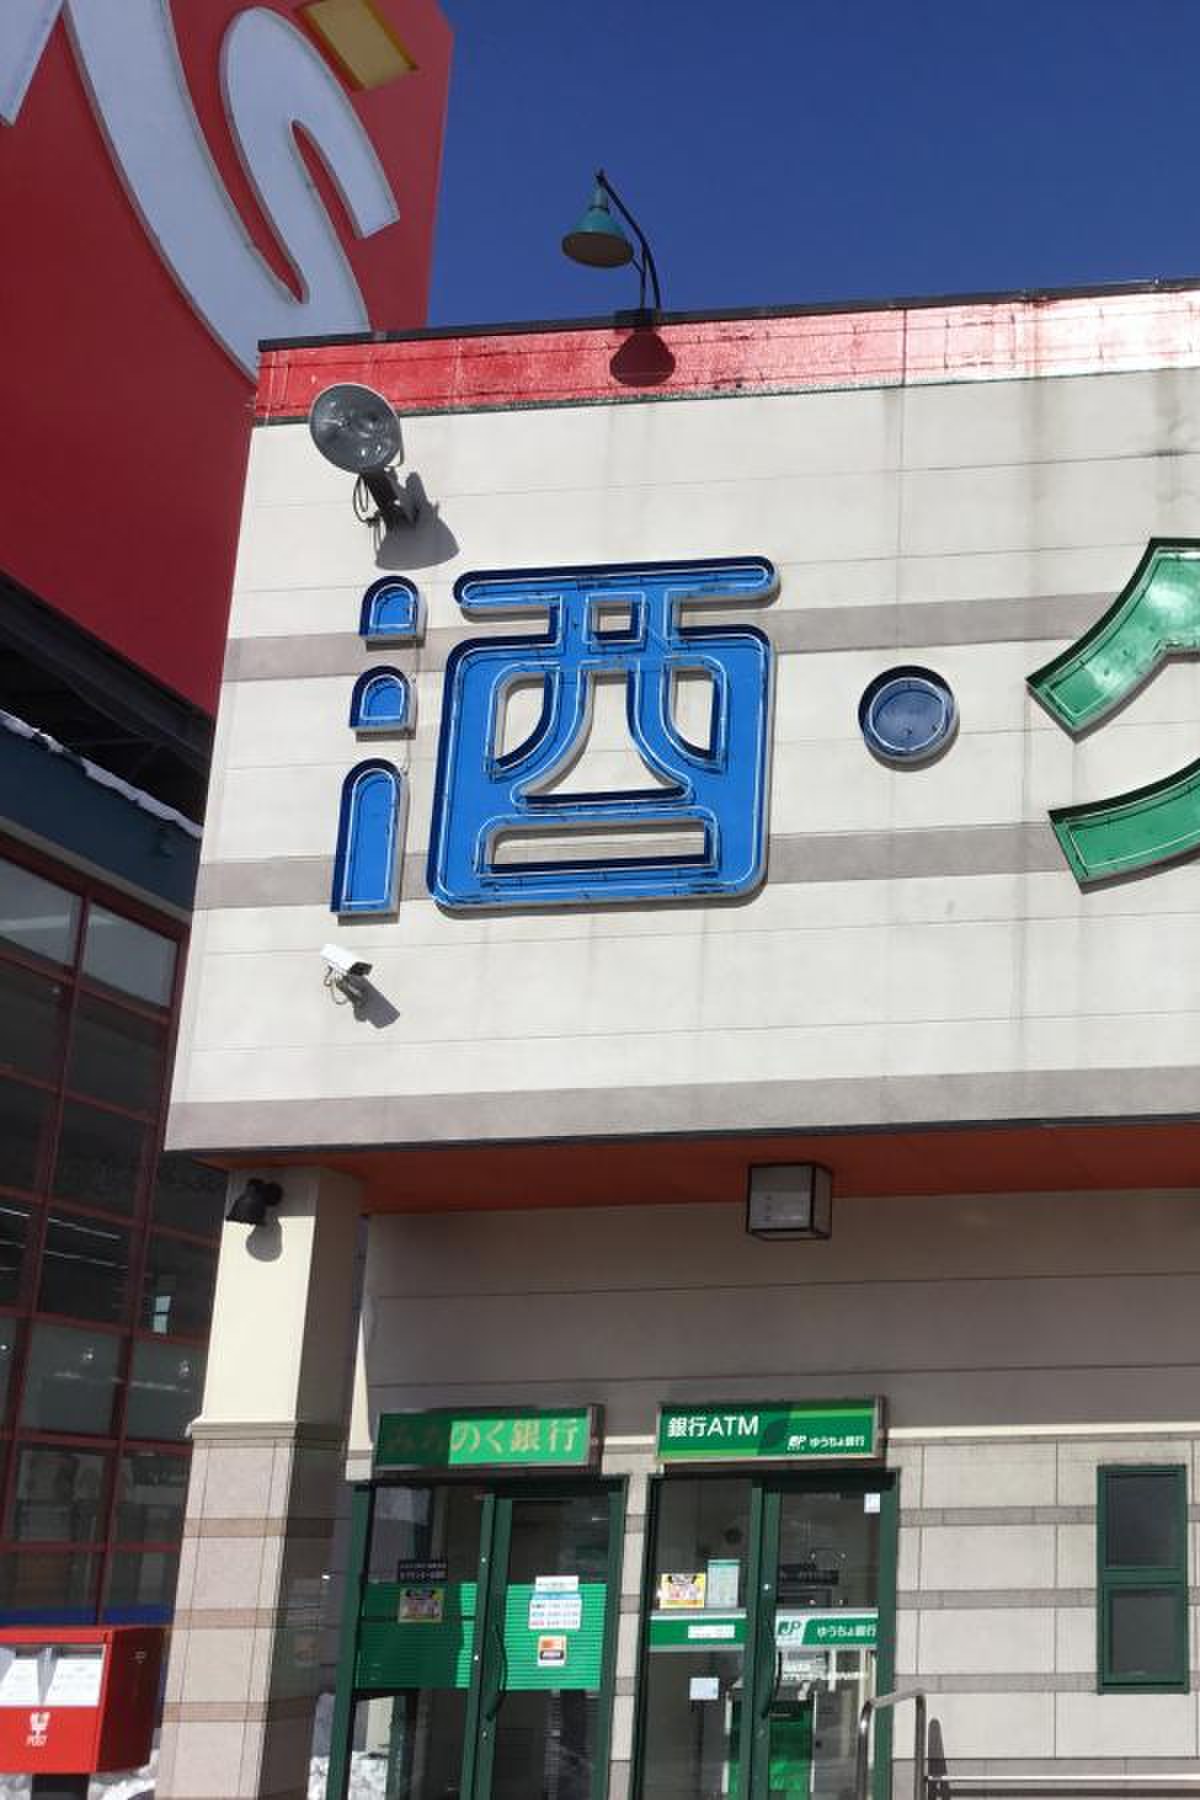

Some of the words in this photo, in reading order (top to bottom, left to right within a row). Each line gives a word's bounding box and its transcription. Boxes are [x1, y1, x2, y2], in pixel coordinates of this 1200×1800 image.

[667, 1415, 760, 1438] 銀行ATM
[809, 1434, 865, 1448] ゆうちょ銀行
